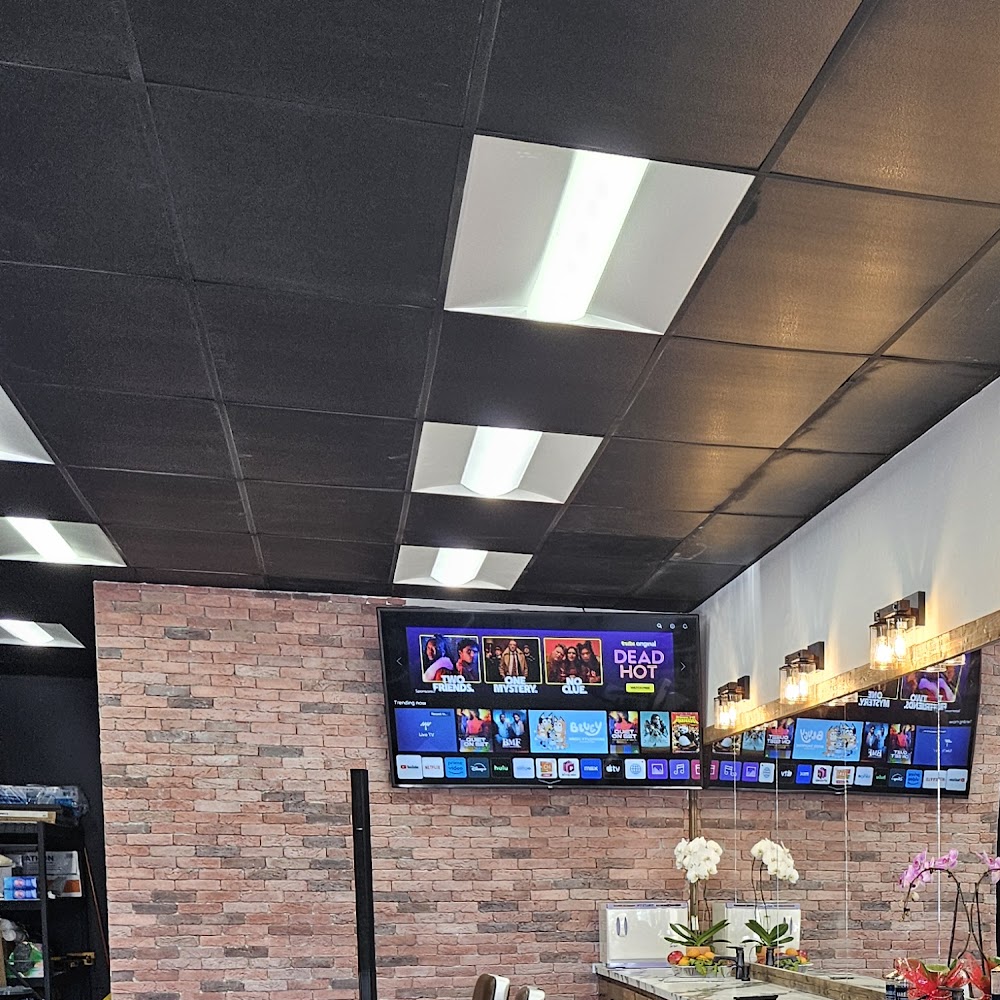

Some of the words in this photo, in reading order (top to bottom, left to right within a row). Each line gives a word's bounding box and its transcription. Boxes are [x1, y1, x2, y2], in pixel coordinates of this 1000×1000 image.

[614, 649, 665, 665] DEAD
[620, 664, 658, 679] HOT
[441, 675, 465, 684] TWO
[504, 676, 526, 685] ONE
[566, 677, 582, 686] NO
[433, 683, 475, 692] FRIENDS.
[494, 684, 538, 693] MYSTERY.
[562, 685, 588, 694] CLUE.
[502, 738, 521, 747] BMF
